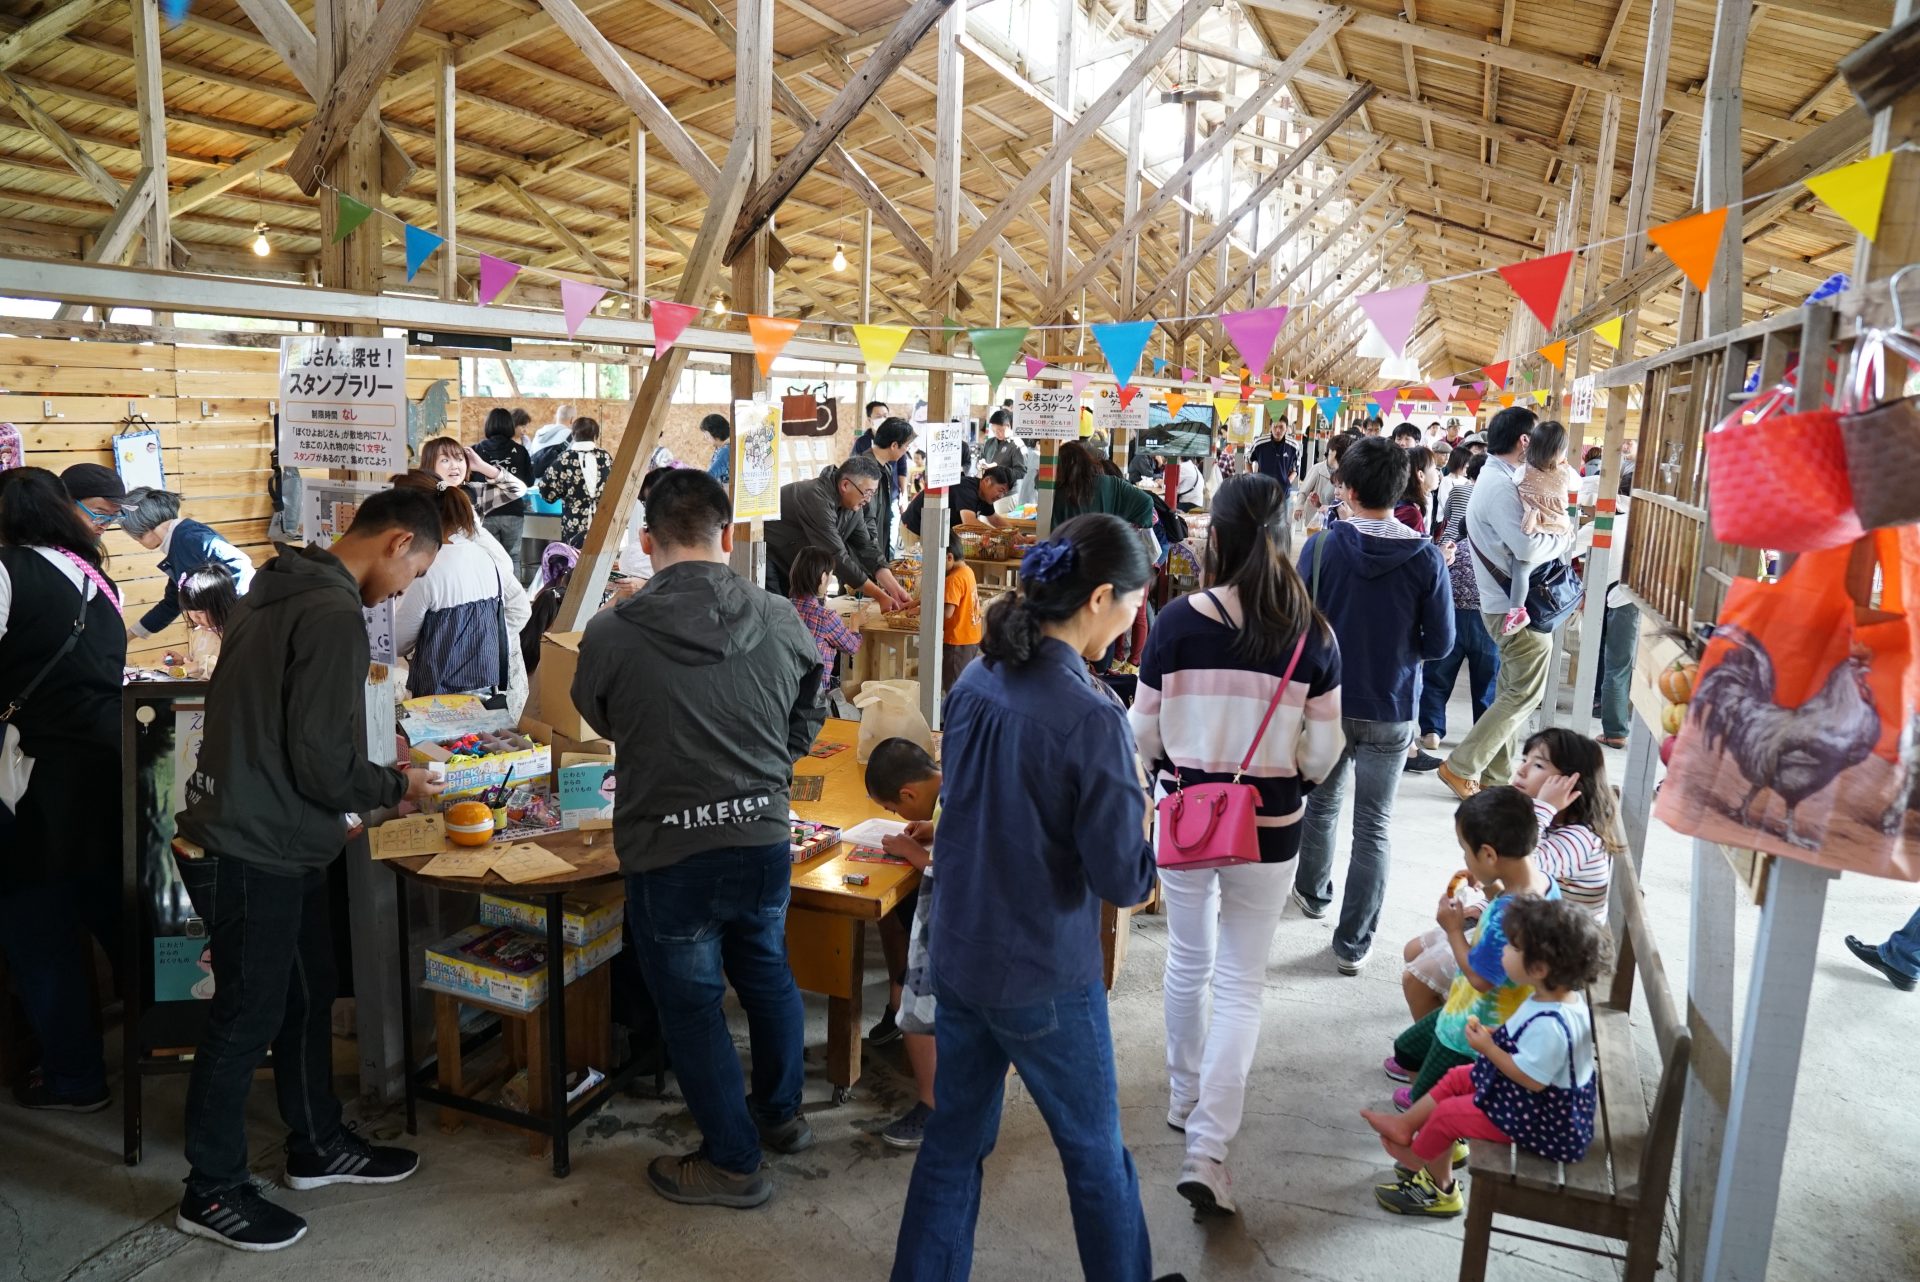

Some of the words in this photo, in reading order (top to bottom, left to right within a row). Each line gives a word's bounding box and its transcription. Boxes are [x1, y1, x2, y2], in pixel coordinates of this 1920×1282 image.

[290, 372, 393, 398] スタンプラリー
[311, 409, 338, 420] 制限時間
[342, 408, 358, 421] なし
[447, 766, 479, 781] DUCK
[448, 772, 492, 789] BUBBLE
[564, 786, 592, 794] おくりもの
